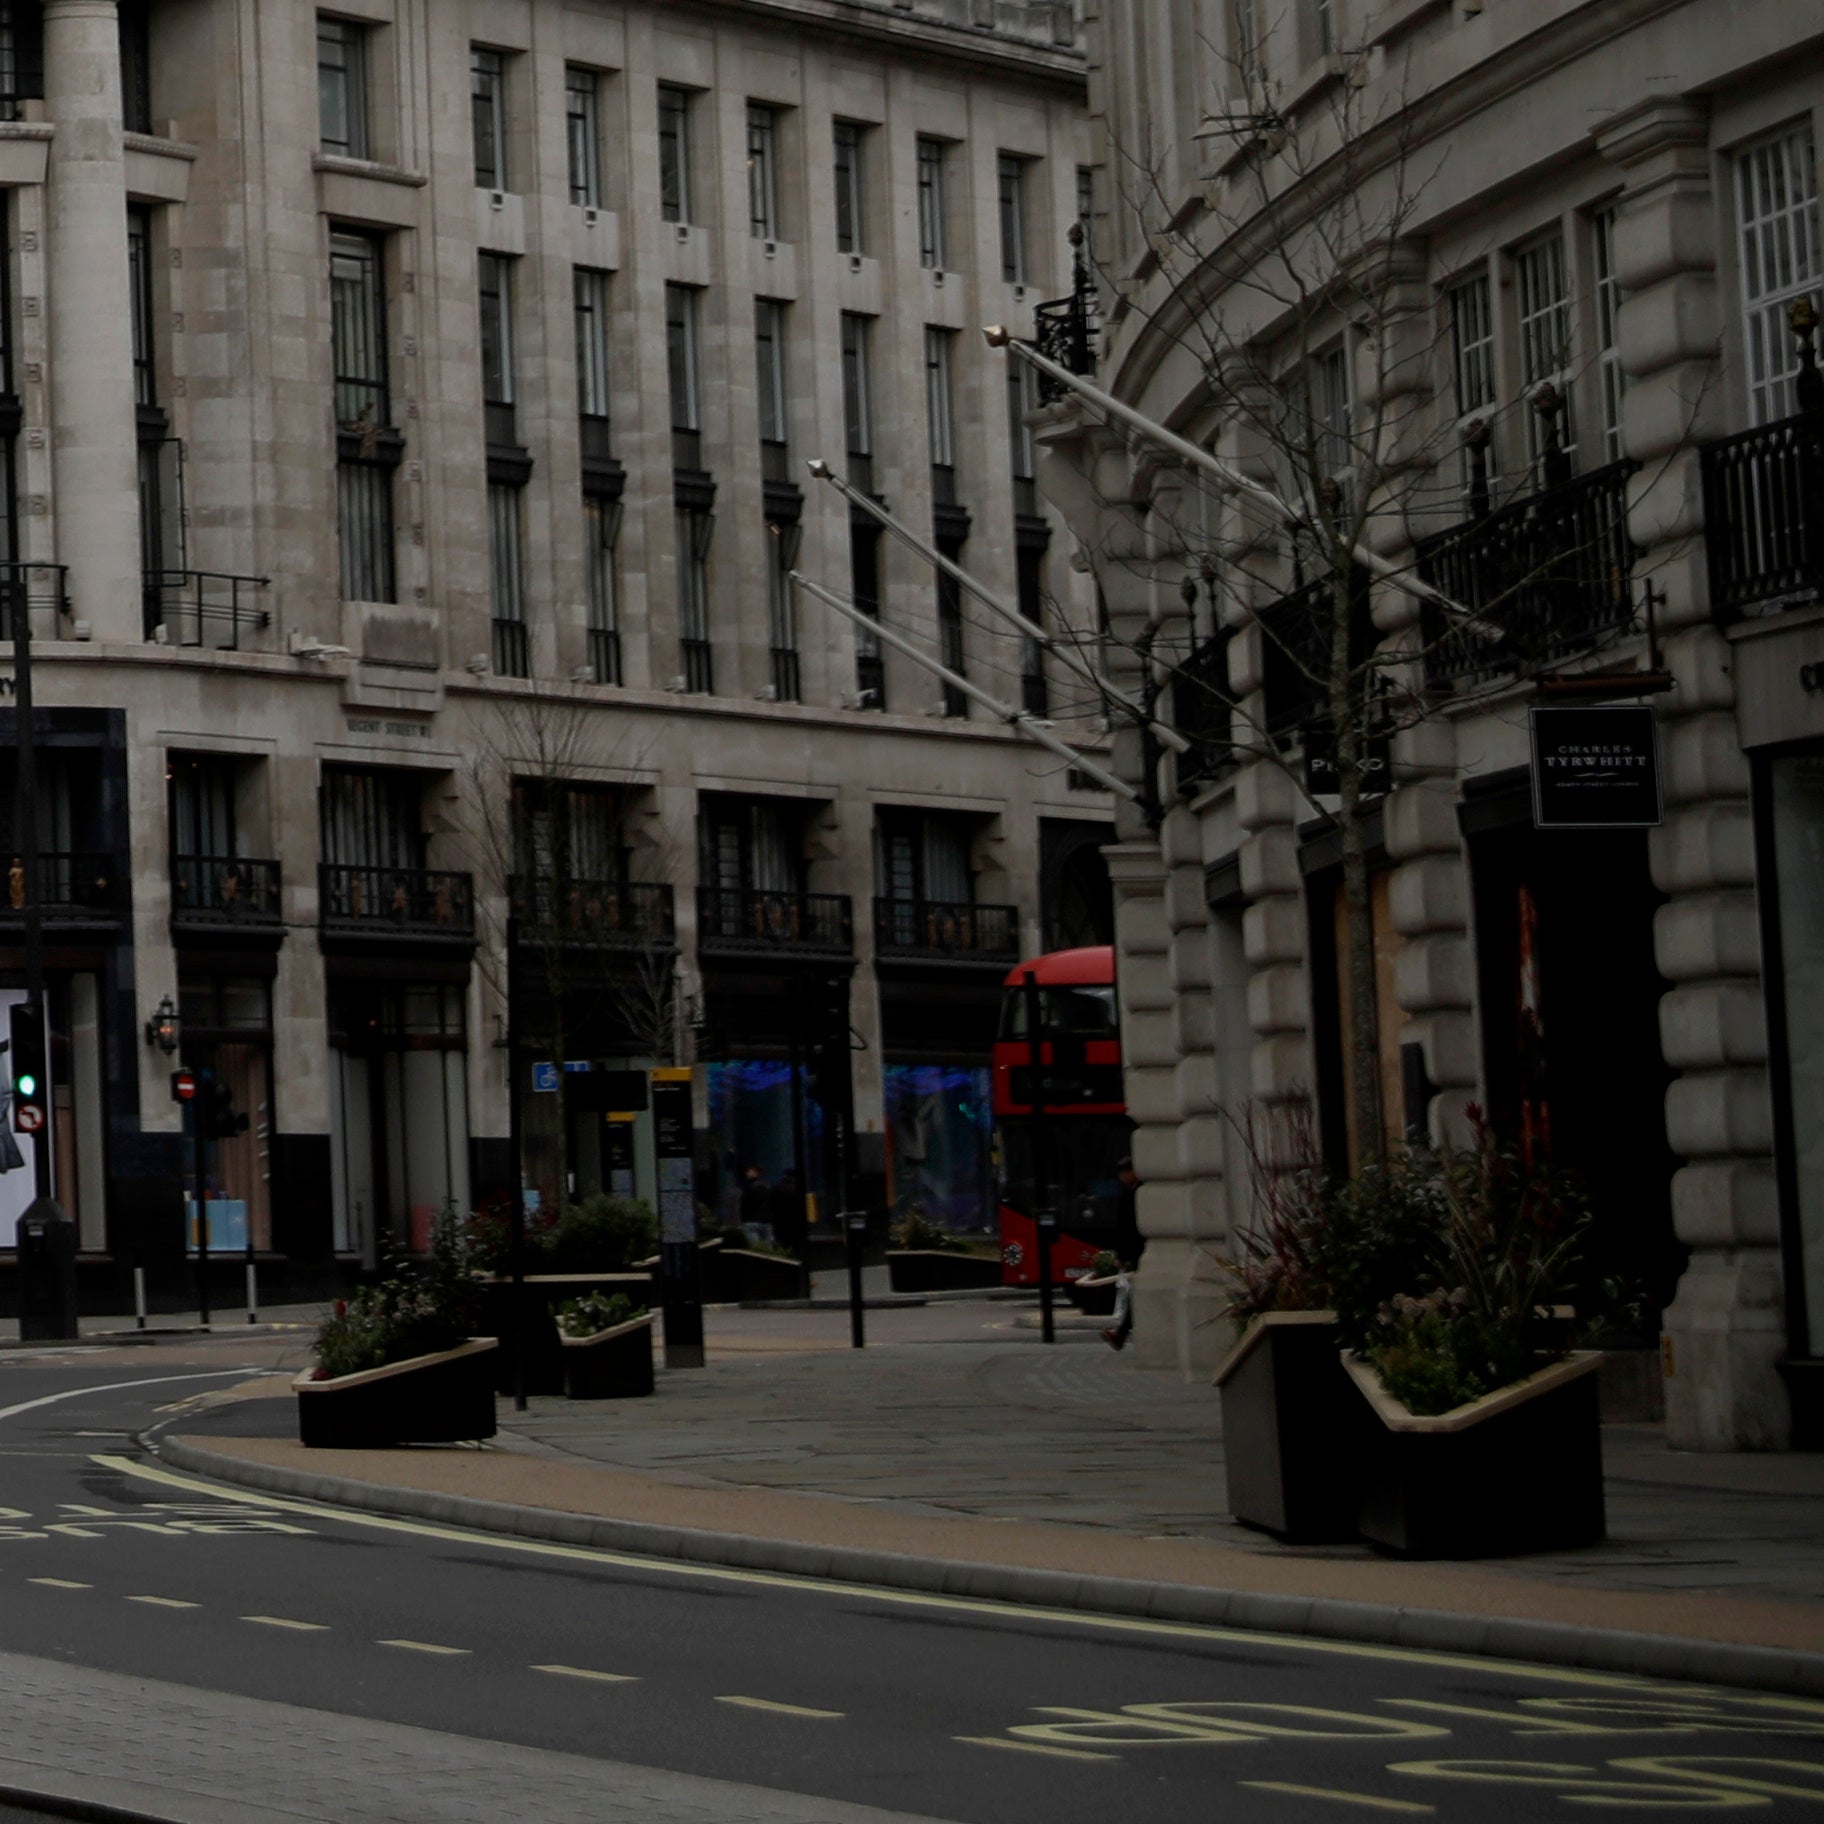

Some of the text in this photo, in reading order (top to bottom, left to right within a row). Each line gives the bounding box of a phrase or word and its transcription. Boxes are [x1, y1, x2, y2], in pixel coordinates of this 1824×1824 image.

[1558, 744, 1634, 754] CHARLES
[1544, 756, 1648, 768] TYRWHITT
[1385, 1756, 1824, 1809] US
